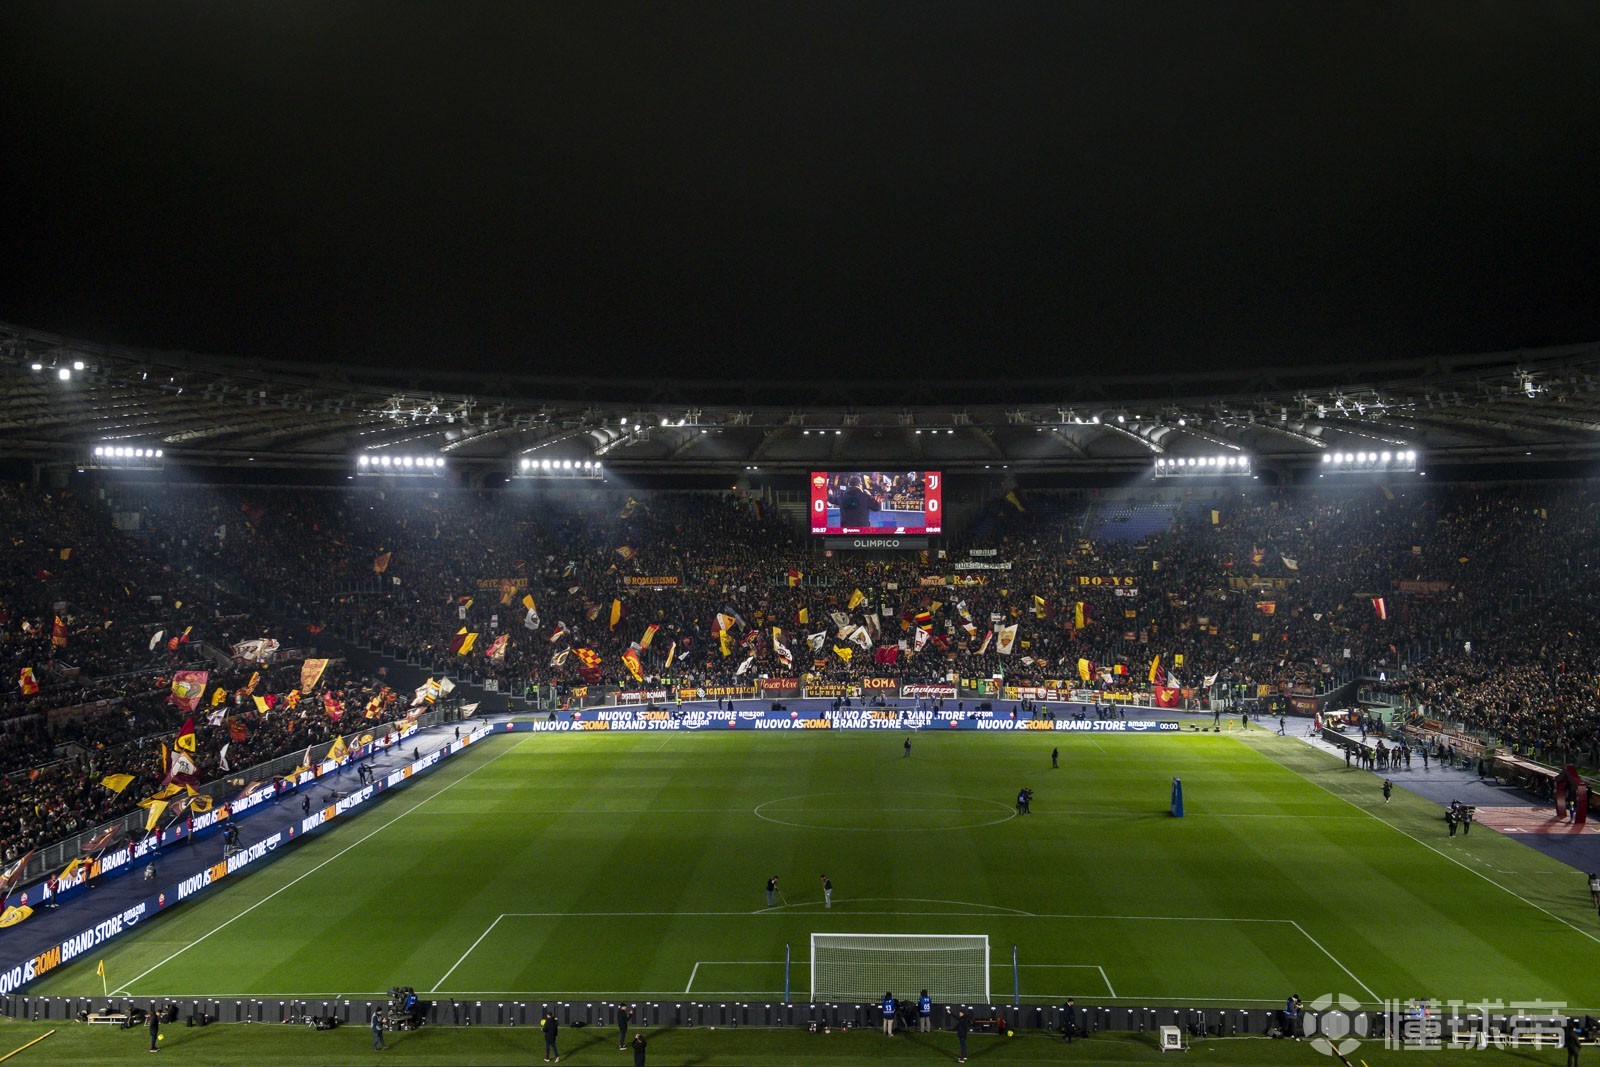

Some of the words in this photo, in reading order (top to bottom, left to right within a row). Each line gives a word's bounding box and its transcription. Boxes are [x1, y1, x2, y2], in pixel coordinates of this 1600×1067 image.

[815, 500, 824, 512] 0
[928, 499, 938, 511] 0
[864, 679, 895, 688] ROMA
[598, 711, 631, 720] NUOVO
[634, 711, 669, 720] SROMA
[706, 711, 737, 720] STORE
[738, 711, 764, 719] amazon
[533, 721, 569, 731] NUOVO
[611, 720, 646, 730] BRAND
[647, 720, 680, 729] STORE
[682, 719, 709, 727] amazon
[755, 719, 790, 729] NUOVO
[832, 719, 868, 728] BRAND
[869, 719, 902, 728] STORE
[977, 719, 1013, 729] NUOVO
[1055, 720, 1092, 730] BRAND
[1093, 720, 1126, 730] STORE
[102, 850, 125, 872] BRAND
[178, 873, 202, 900] NUOVO
[227, 850, 248, 874] BRAND
[248, 840, 267, 862] STORE
[0, 966, 21, 993] OVO
[62, 929, 94, 962] BRAND
[95, 914, 122, 944] STORE
[123, 903, 145, 923] amazon
